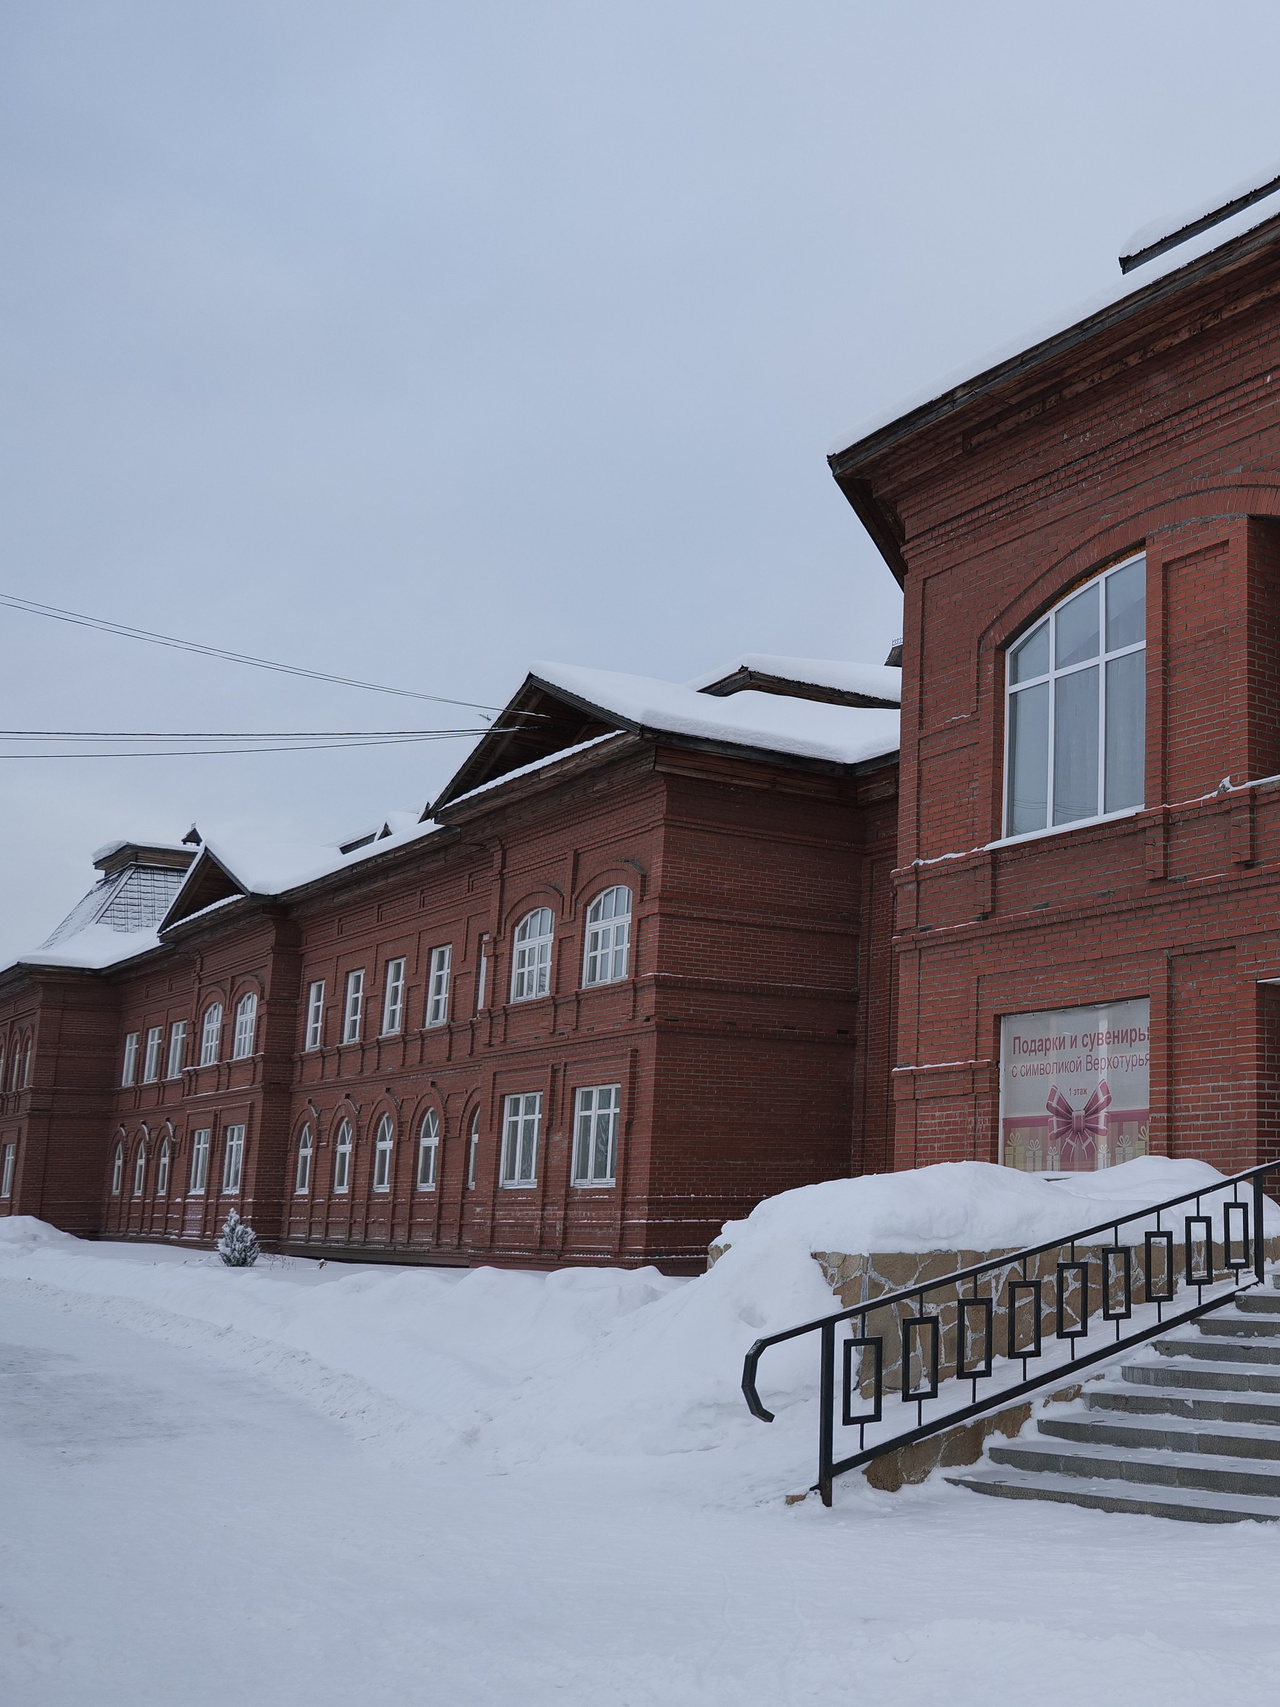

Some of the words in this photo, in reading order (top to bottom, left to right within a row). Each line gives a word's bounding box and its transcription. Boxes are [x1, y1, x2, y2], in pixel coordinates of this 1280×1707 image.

[1012, 1035, 1066, 1056] Подарки
[1069, 1034, 1078, 1049] и
[1081, 1026, 1150, 1052] сувениры
[1011, 1065, 1018, 1078] с
[1019, 1056, 1083, 1078] символикой
[1085, 1052, 1150, 1075] Верхотурья
[1073, 1087, 1088, 1096] этаж
